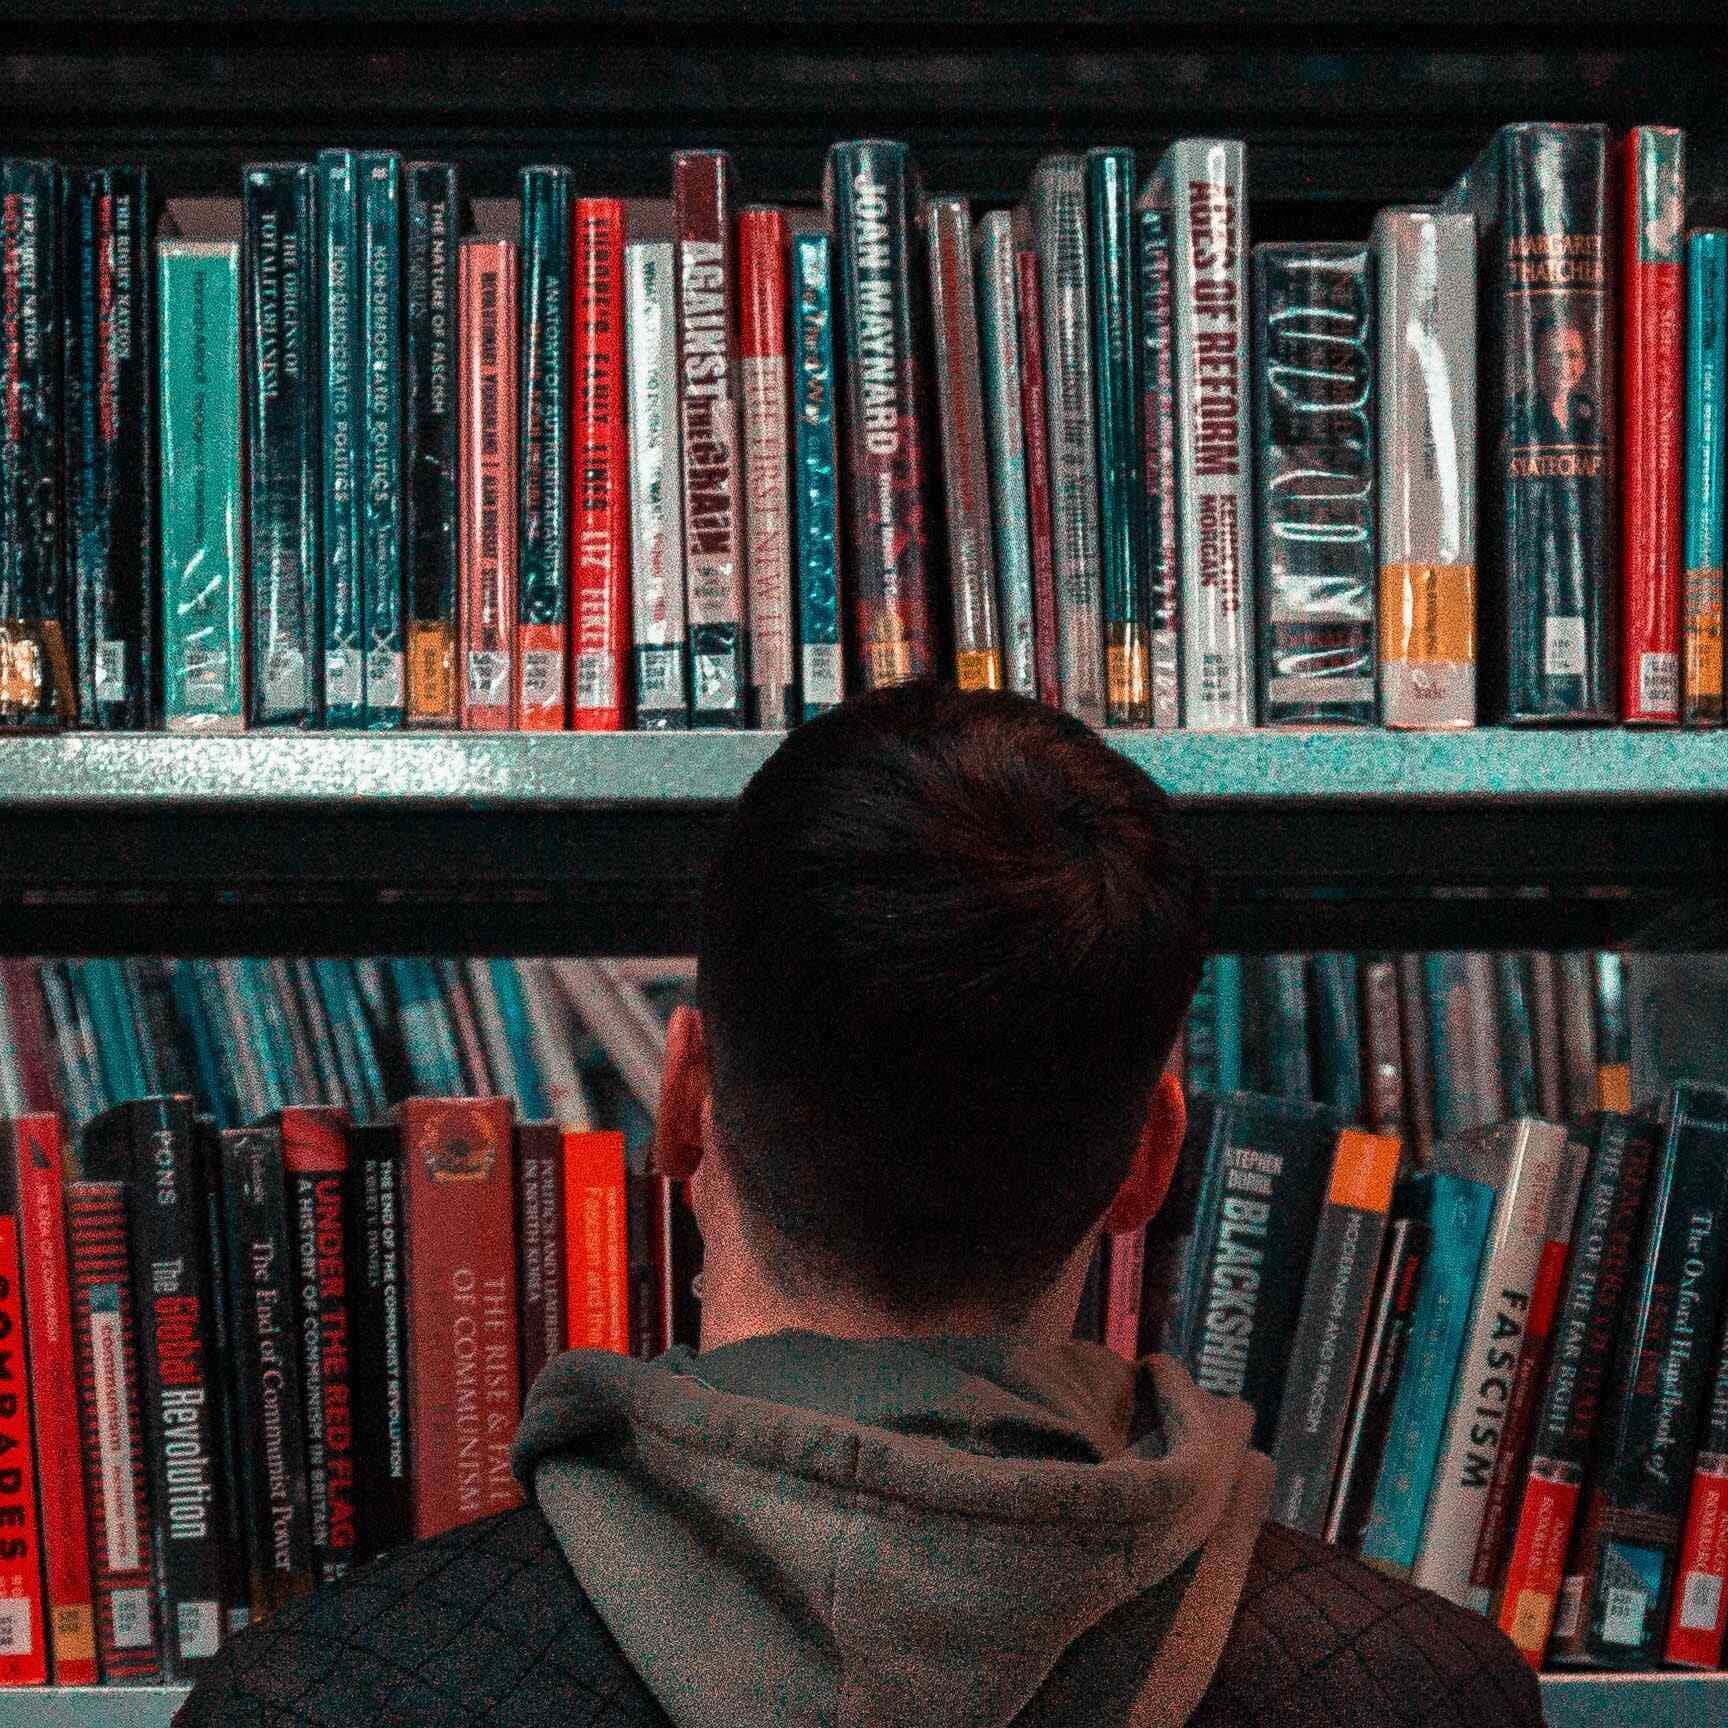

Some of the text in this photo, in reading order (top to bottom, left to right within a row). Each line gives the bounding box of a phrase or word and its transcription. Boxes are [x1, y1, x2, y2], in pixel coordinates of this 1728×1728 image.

[682, 240, 731, 555] AGAINST THE GRAIN
[853, 174, 901, 455] JOAN MAYNARD
[1189, 180, 1241, 476] AGES OF REFORM
[154, 1130, 175, 1205] PONS
[151, 1259, 212, 1539] The Global Revolution
[253, 1238, 294, 1571] The End of Communist Power
[298, 1179, 327, 1545] A HISTORY OF COMMUNISM IN BRITAIN
[314, 1179, 355, 1547] UNDER THE RED FLAG
[454, 1268, 482, 1511] OF COMMUNISM
[483, 1277, 512, 1504] THE RISE & FALL
[1460, 1289, 1529, 1488] FASCISM
